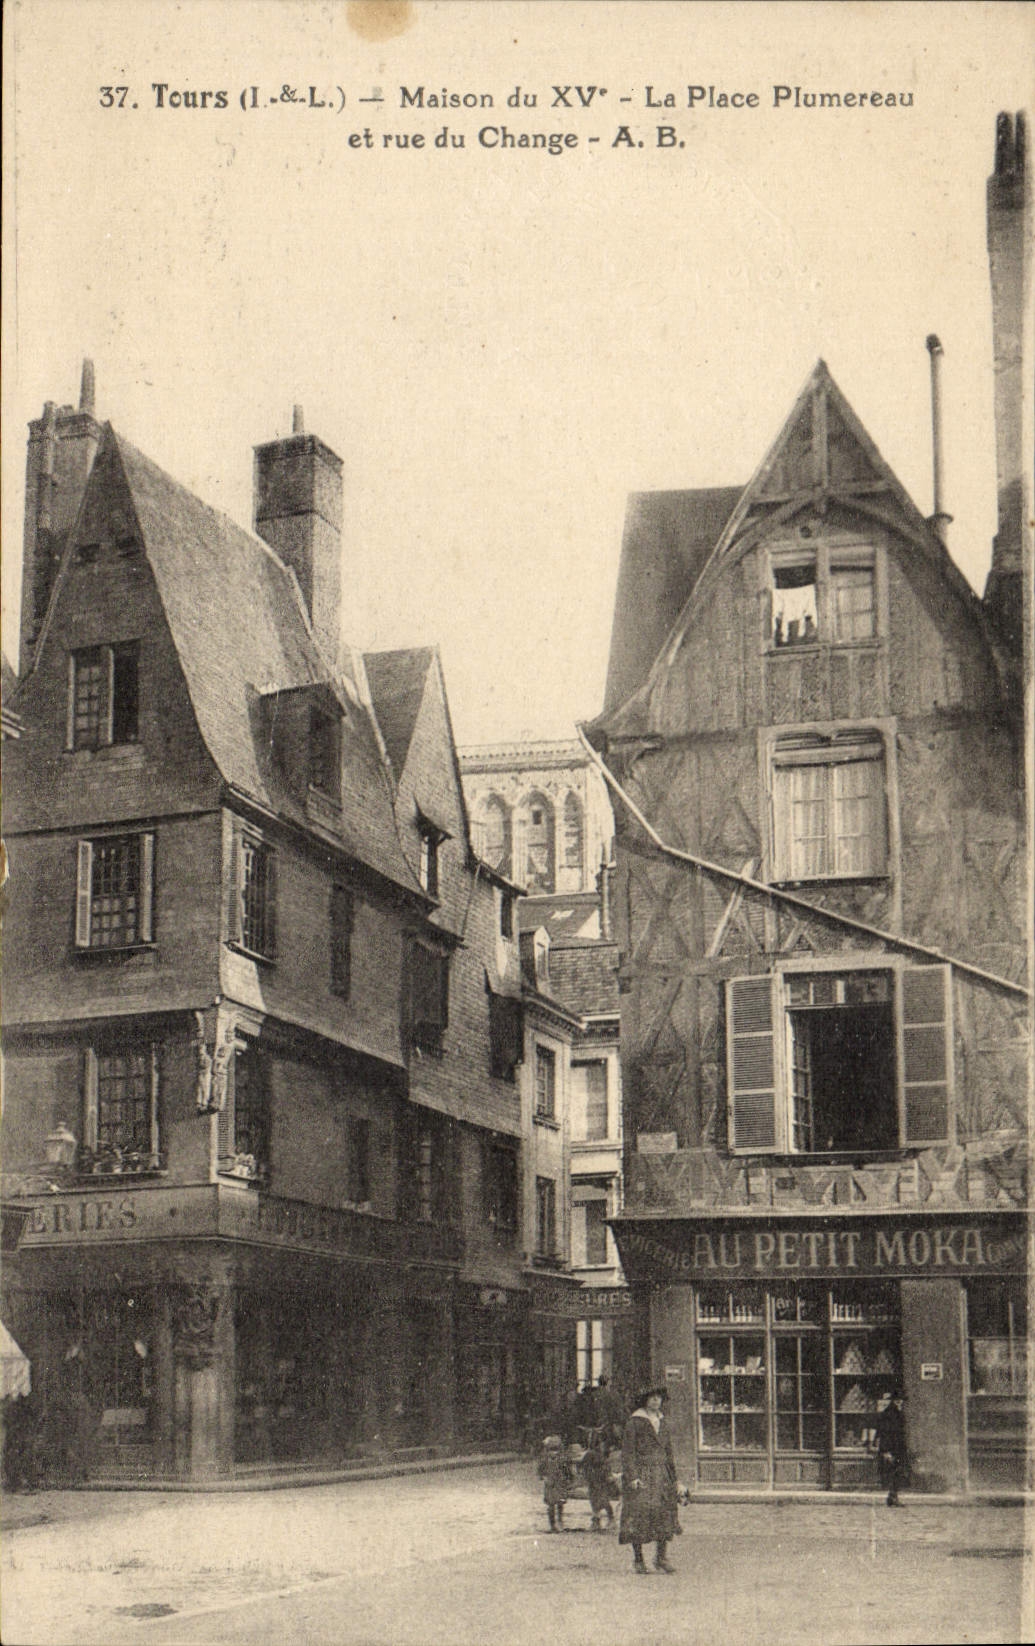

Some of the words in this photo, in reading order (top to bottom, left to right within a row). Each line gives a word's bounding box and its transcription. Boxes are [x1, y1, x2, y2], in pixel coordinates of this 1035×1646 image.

[693, 1232, 741, 1269] AU
[754, 1231, 861, 1269] PETIT
[873, 1229, 986, 1266] MOKA
